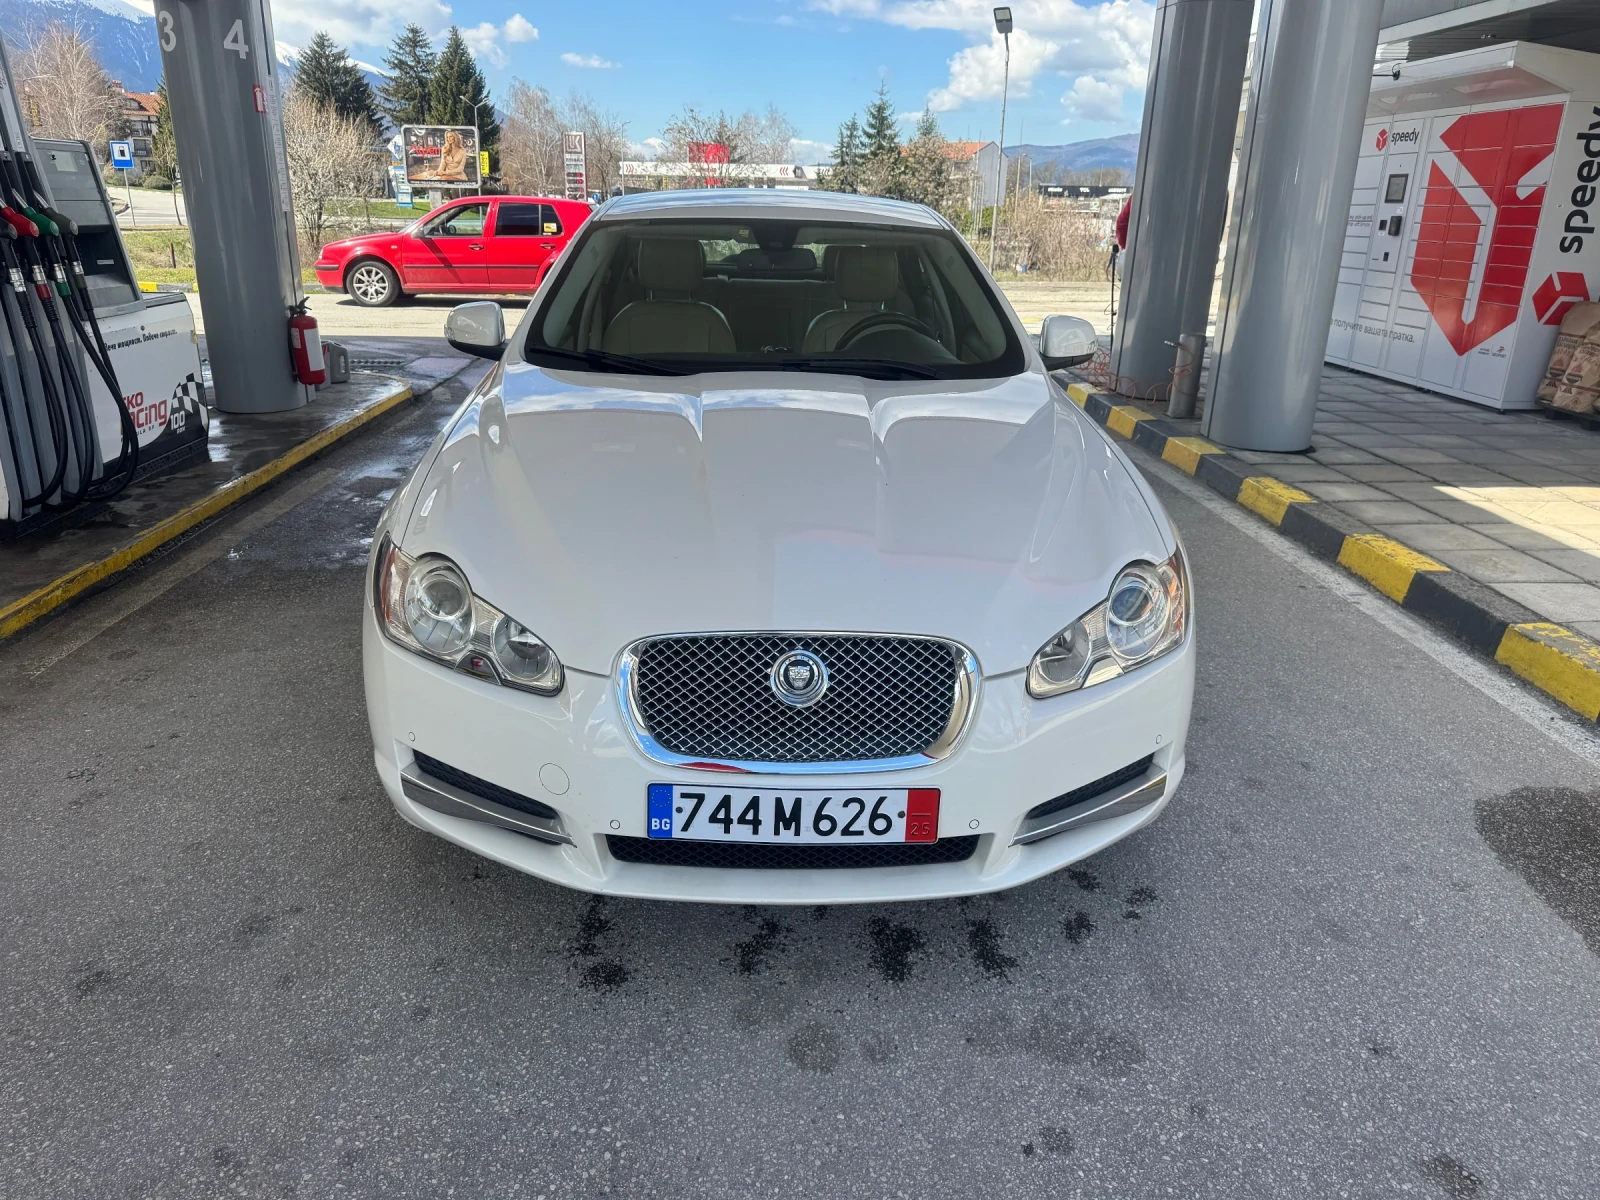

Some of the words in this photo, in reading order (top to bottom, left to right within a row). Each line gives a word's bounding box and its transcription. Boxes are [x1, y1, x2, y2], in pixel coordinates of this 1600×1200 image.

[158, 10, 177, 52] 3
[223, 18, 250, 60] 4
[1391, 127, 1420, 146] speedy
[170, 410, 186, 430] 100
[651, 818, 671, 831] BG
[680, 792, 762, 835] 744
[773, 796, 803, 837] M
[812, 796, 893, 837] 626
[910, 822, 930, 836] 25
